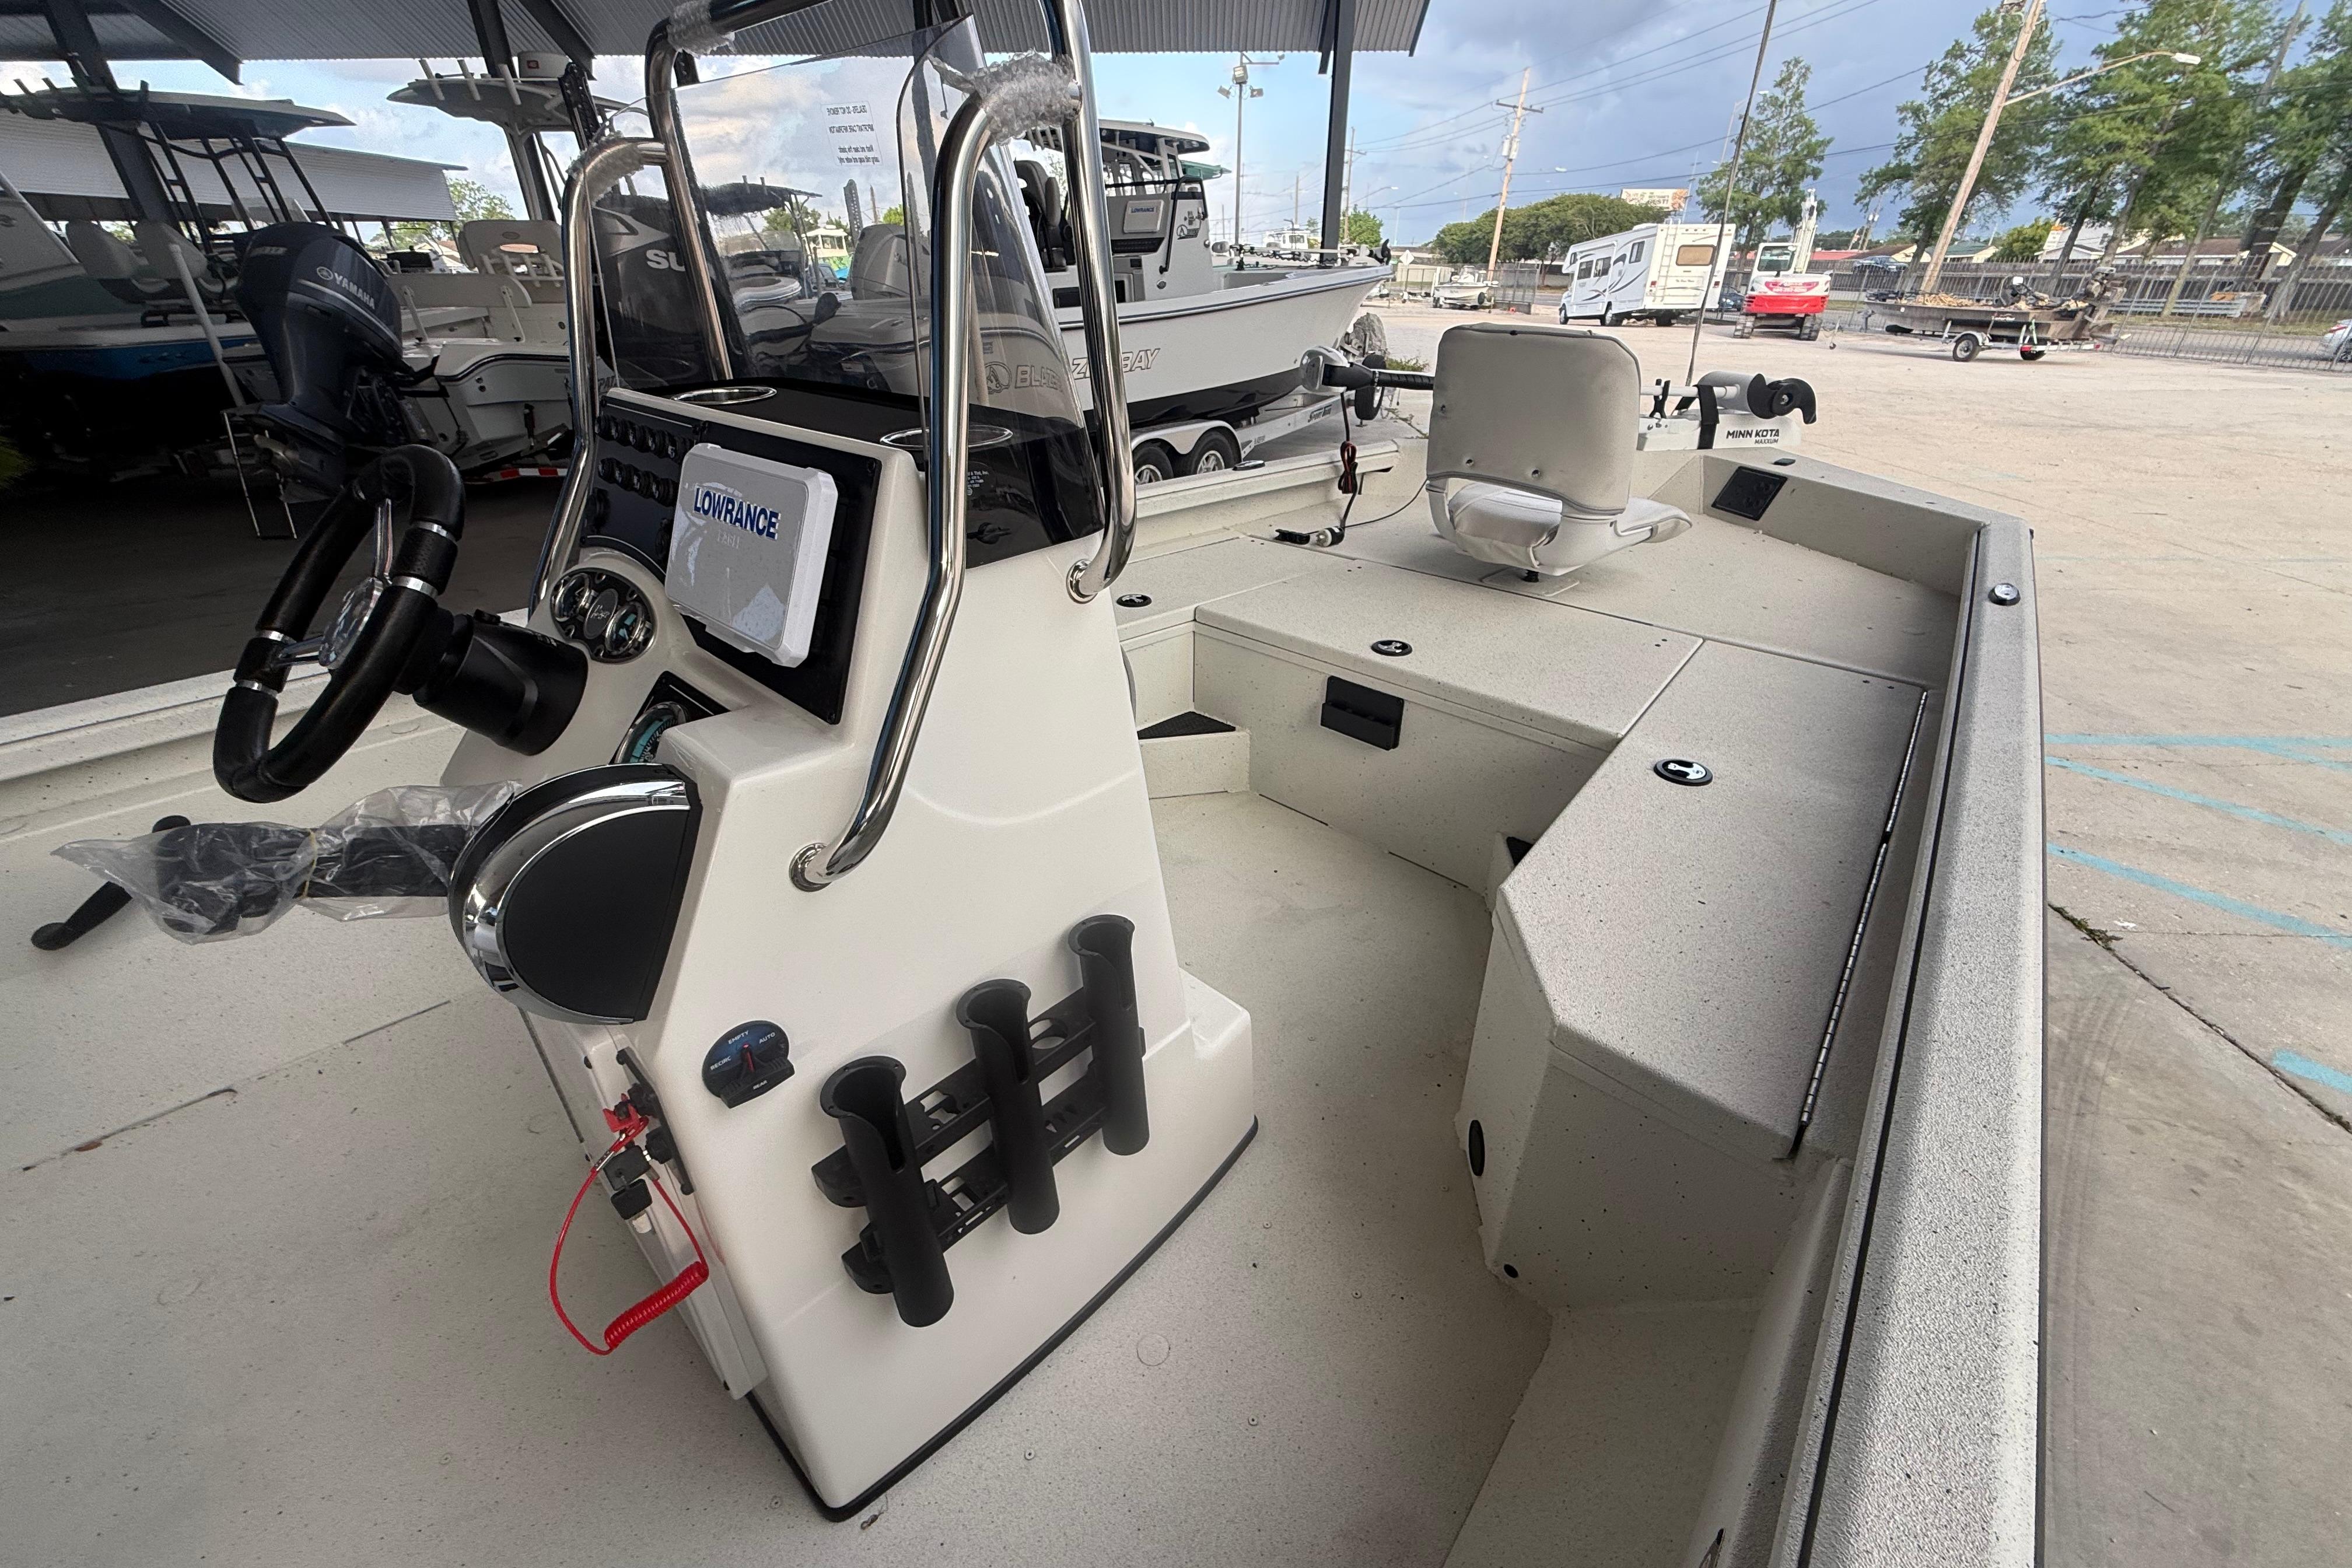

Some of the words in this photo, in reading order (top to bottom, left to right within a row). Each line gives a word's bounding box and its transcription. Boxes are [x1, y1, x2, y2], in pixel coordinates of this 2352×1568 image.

[334, 272, 375, 310] YAMAHA
[1726, 429, 1754, 439] MINN
[1755, 429, 1779, 438] KOTA
[694, 487, 780, 540] LOWRANCE
[728, 1030, 749, 1044] EMPTY
[759, 1032, 775, 1044] AUTO
[710, 1056, 731, 1070] RECIRC
[753, 1080, 768, 1090] REAR
